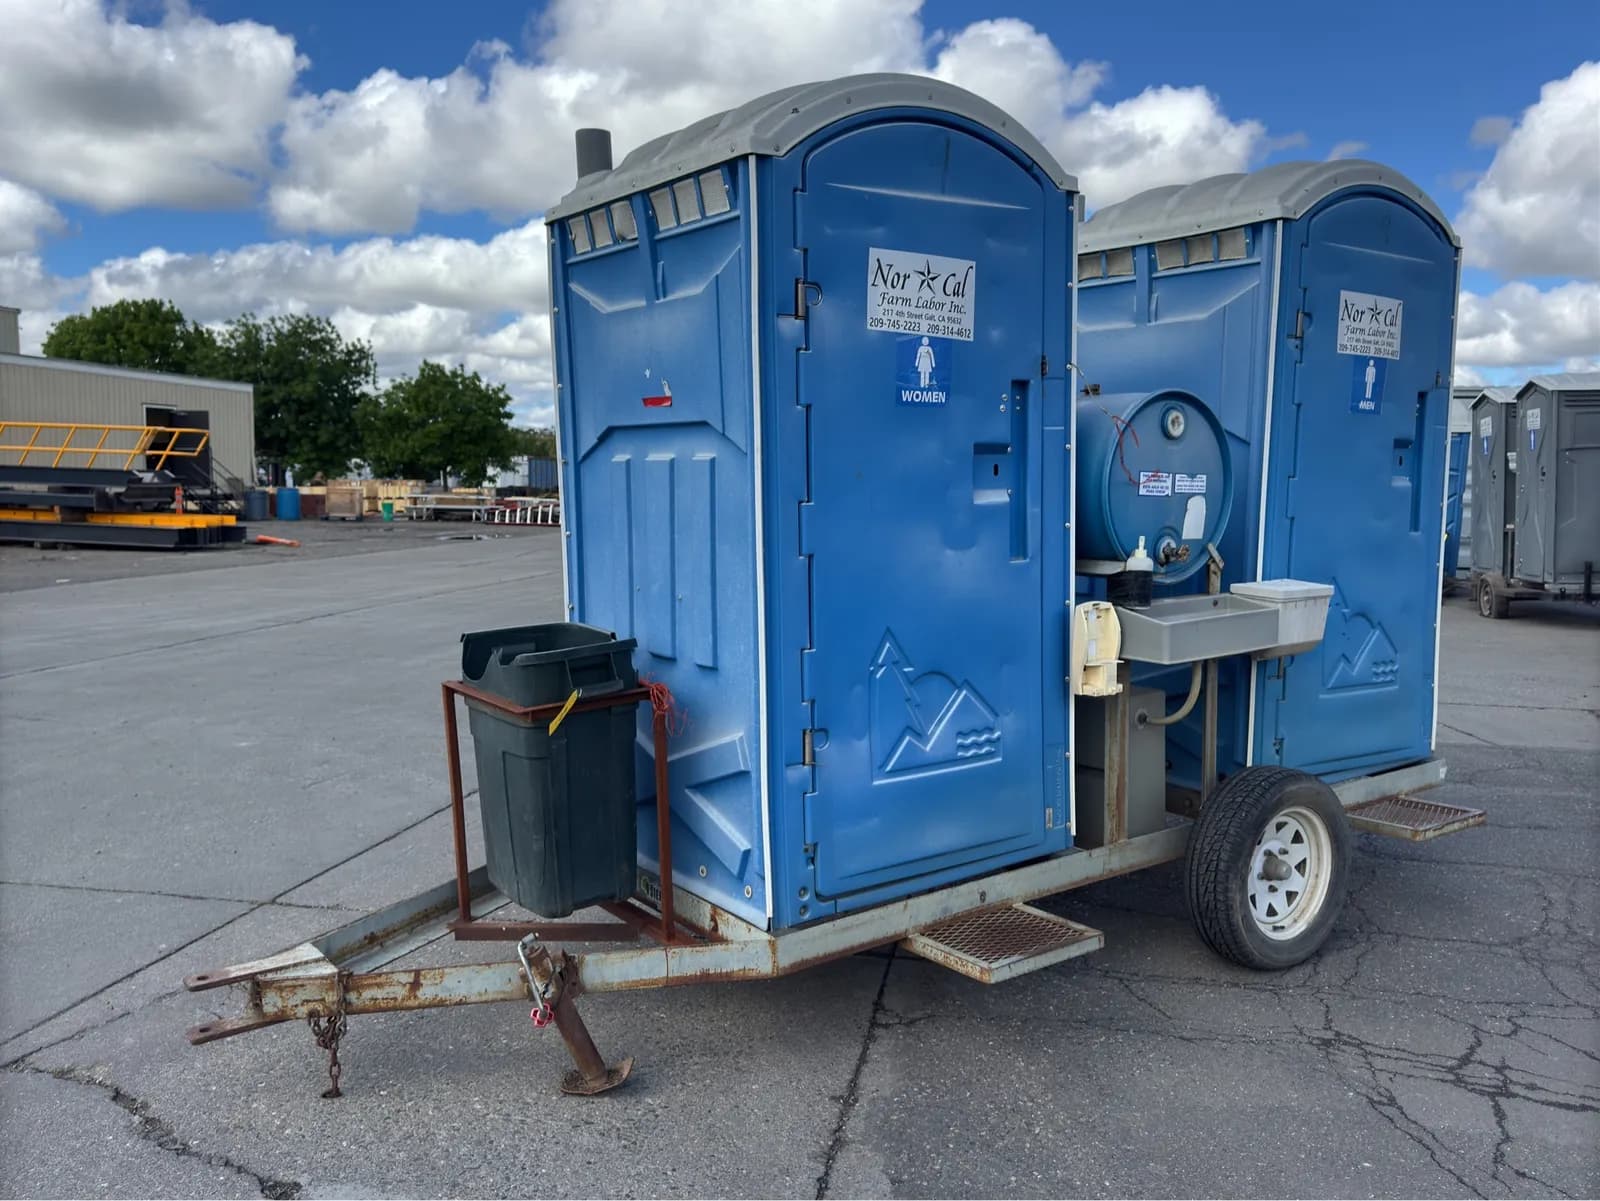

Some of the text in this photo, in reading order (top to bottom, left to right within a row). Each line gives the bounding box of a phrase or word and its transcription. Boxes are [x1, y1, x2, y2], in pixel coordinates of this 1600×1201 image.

[871, 257, 974, 298] Nor Cal
[877, 292, 967, 315] Farm Labor Inc.
[1340, 298, 1402, 327] Nor Cal
[882, 308, 894, 317] 217
[895, 310, 905, 318] 4th
[906, 311, 923, 320] Street
[938, 314, 946, 322] CA
[869, 317, 972, 339] 209-745-2223 209-314-4612
[1344, 324, 1366, 336] Farm
[901, 390, 946, 403] WOMEN
[1359, 399, 1376, 411] MEN
